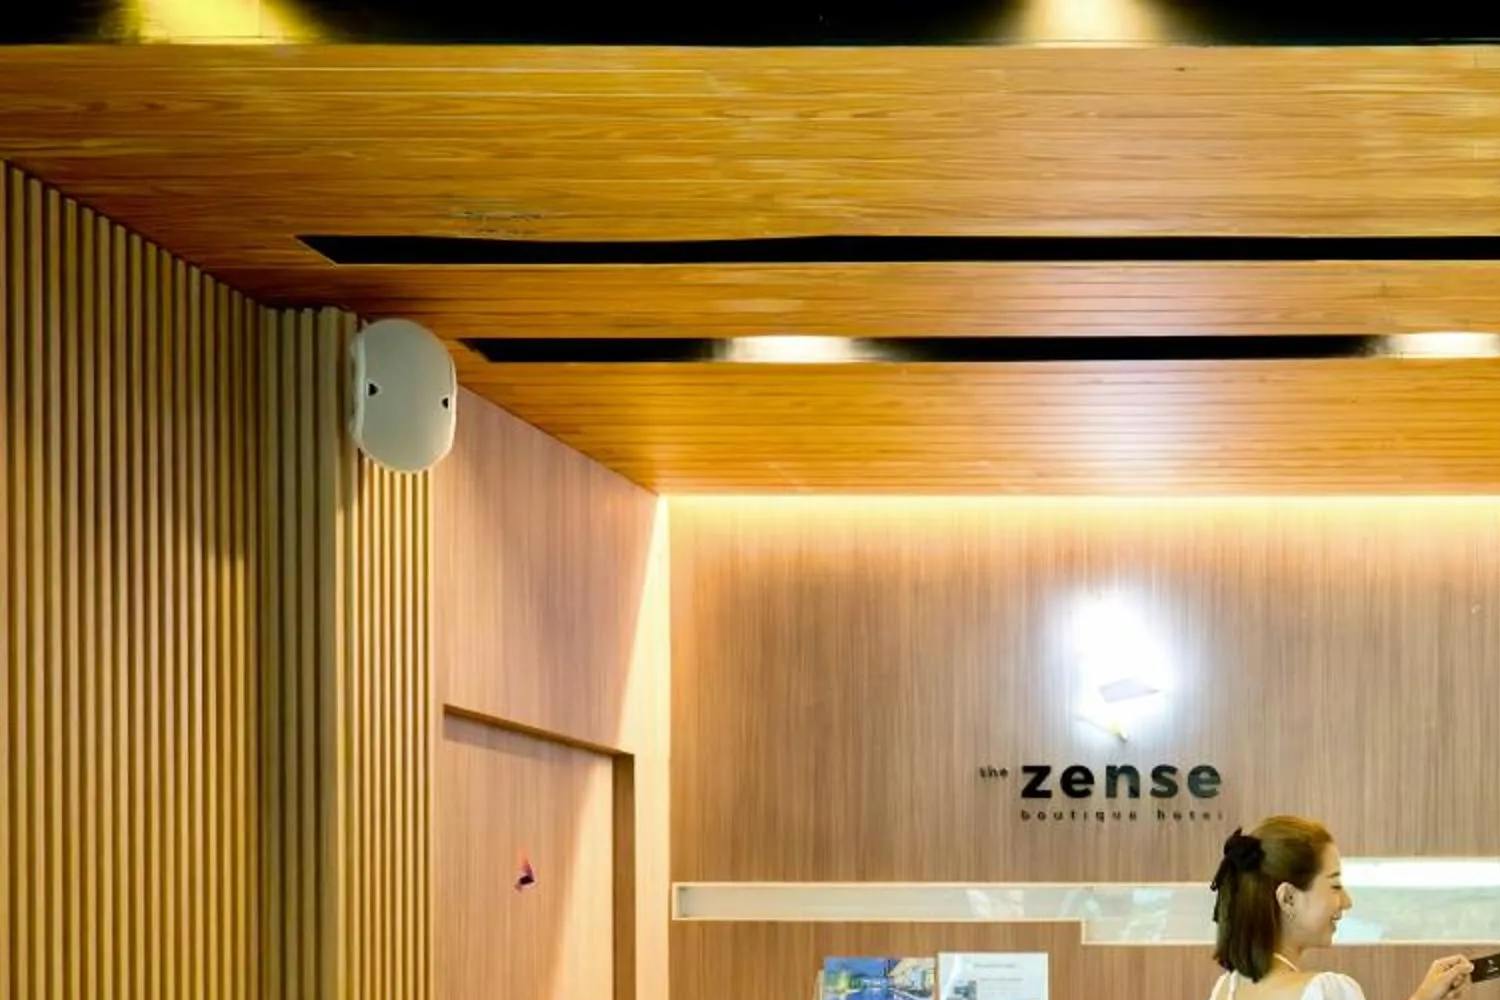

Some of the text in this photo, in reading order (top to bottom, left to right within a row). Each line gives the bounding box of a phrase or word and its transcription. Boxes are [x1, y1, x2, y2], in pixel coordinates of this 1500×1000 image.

[979, 764, 1222, 799] the zense
[1021, 809, 1223, 822] boutique hotel
